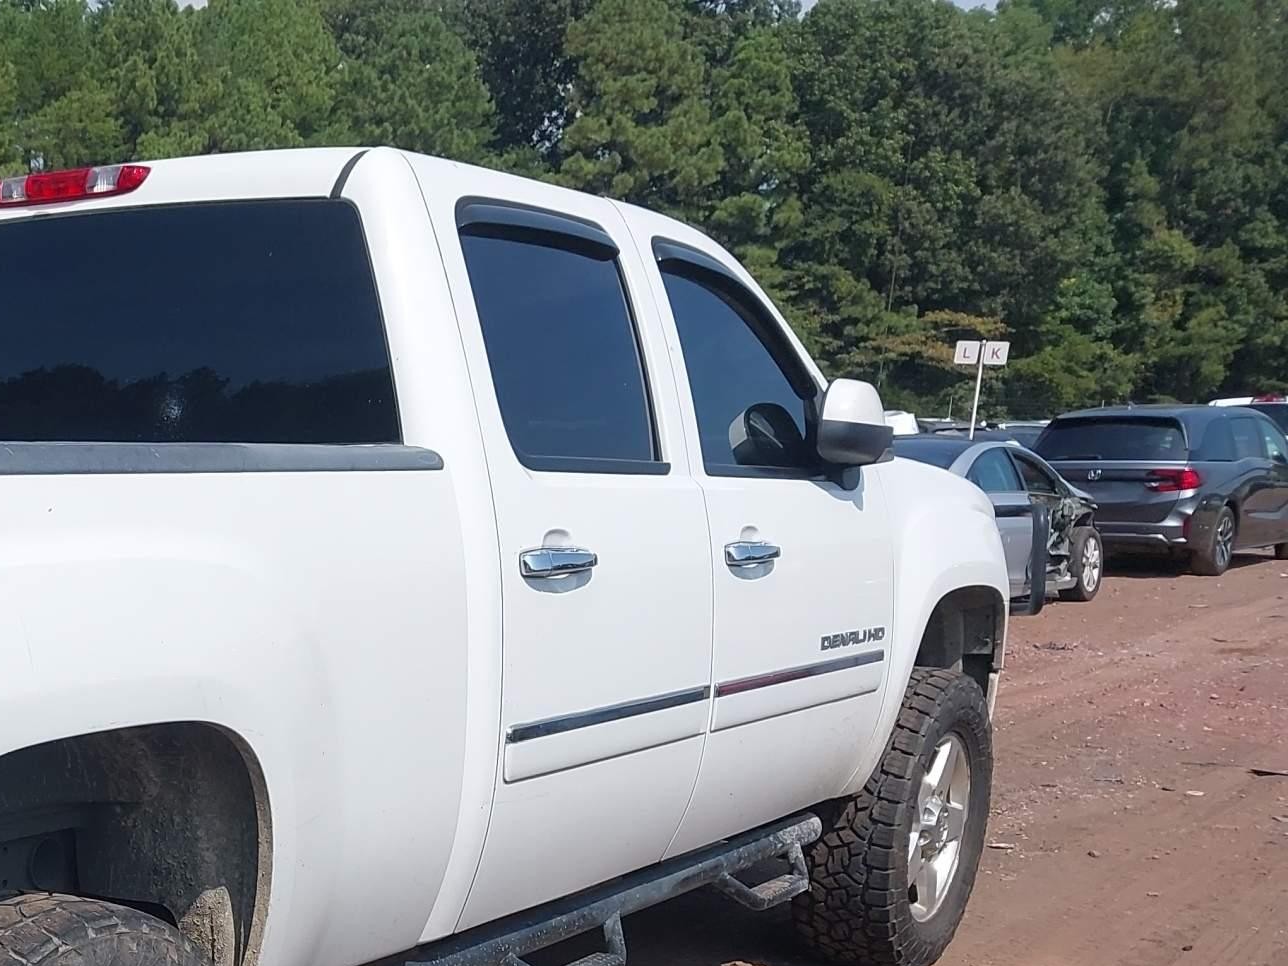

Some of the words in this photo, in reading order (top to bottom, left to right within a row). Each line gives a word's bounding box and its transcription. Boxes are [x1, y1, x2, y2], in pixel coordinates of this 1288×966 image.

[963, 347, 970, 358] L
[991, 348, 1001, 360] K
[821, 629, 867, 650] DENALI
[868, 627, 885, 642] HD
